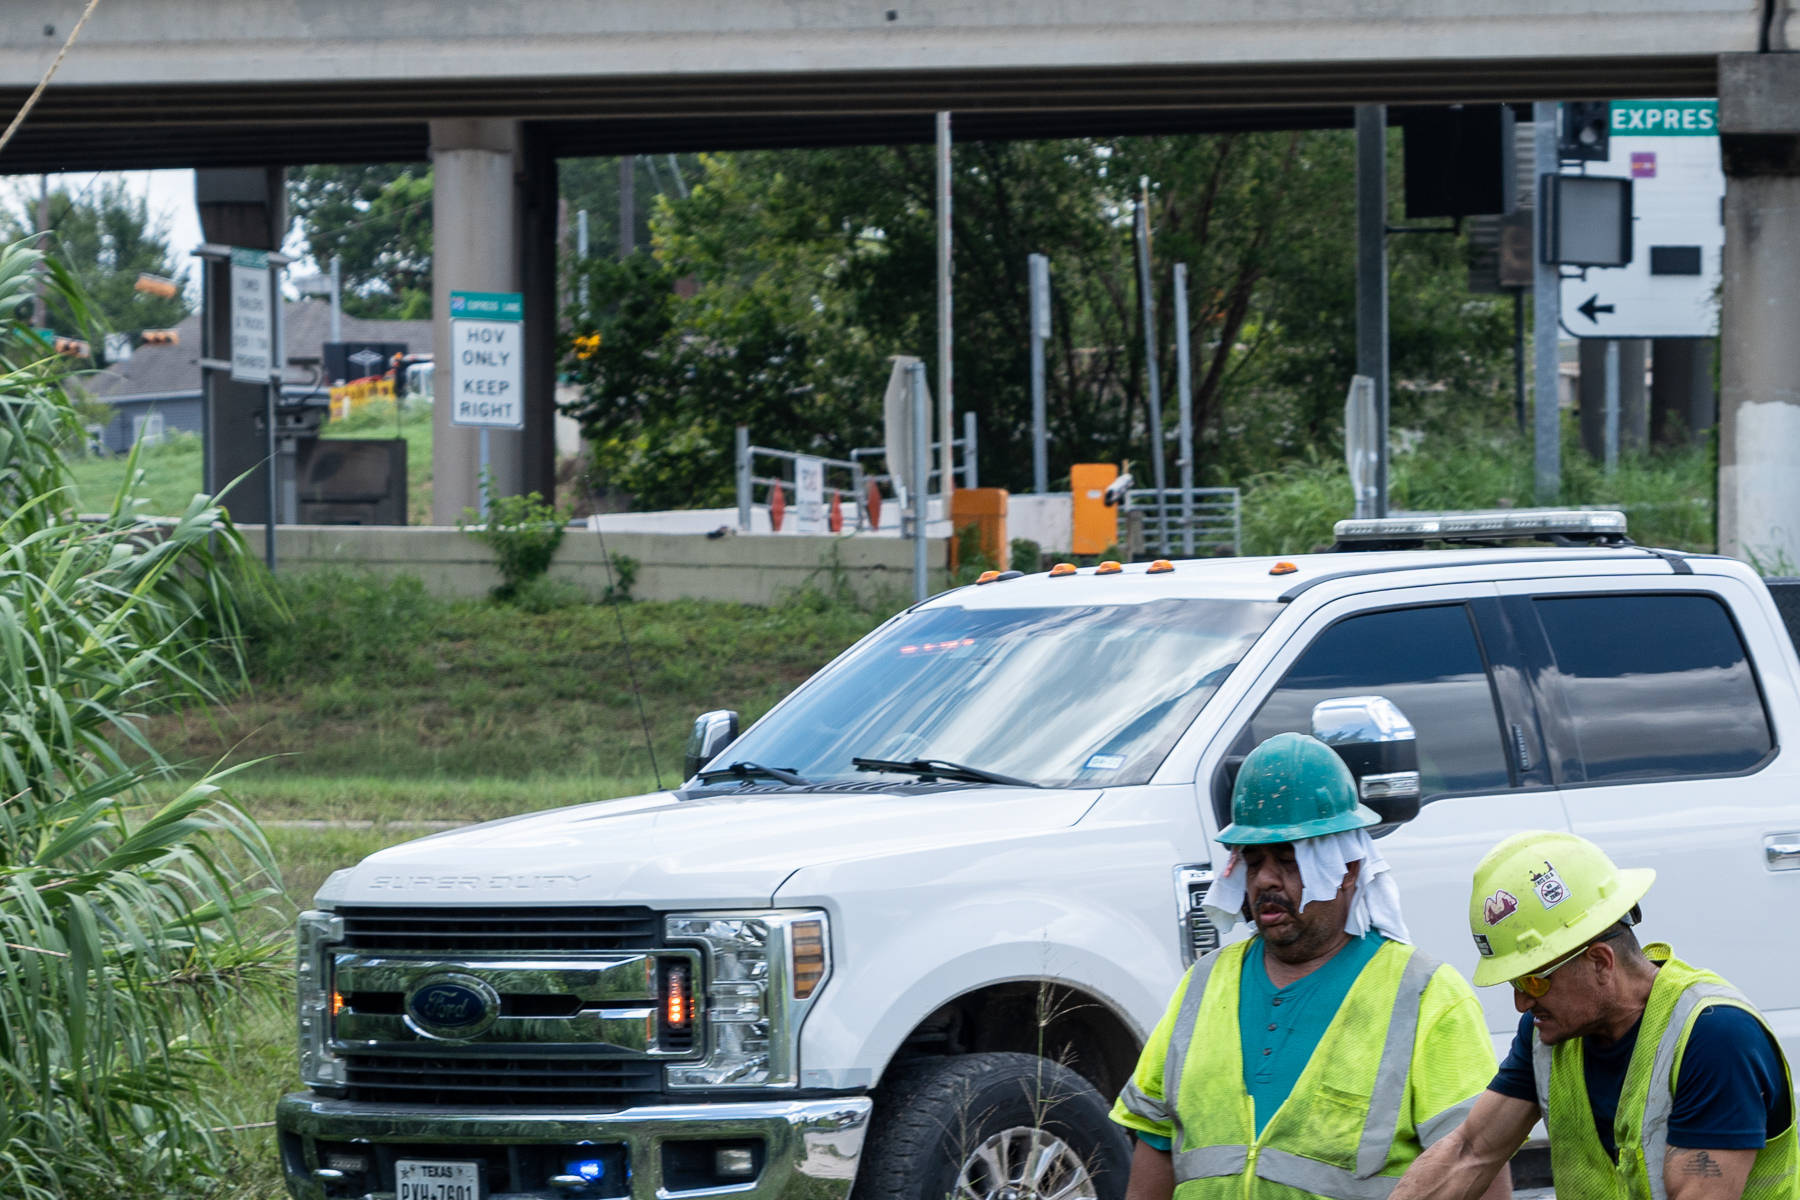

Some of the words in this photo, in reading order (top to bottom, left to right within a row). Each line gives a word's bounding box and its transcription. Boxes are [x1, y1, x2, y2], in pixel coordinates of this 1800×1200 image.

[1611, 108, 1719, 130] EXPRES
[467, 327, 506, 343] HOV
[462, 349, 511, 367] ONLY
[463, 378, 511, 396] KEEP
[459, 401, 513, 418] RIGHT
[368, 875, 482, 889] SUPER
[488, 874, 593, 889] DUTY
[425, 990, 470, 1018] Ford
[421, 1166, 453, 1178] TEXAS
